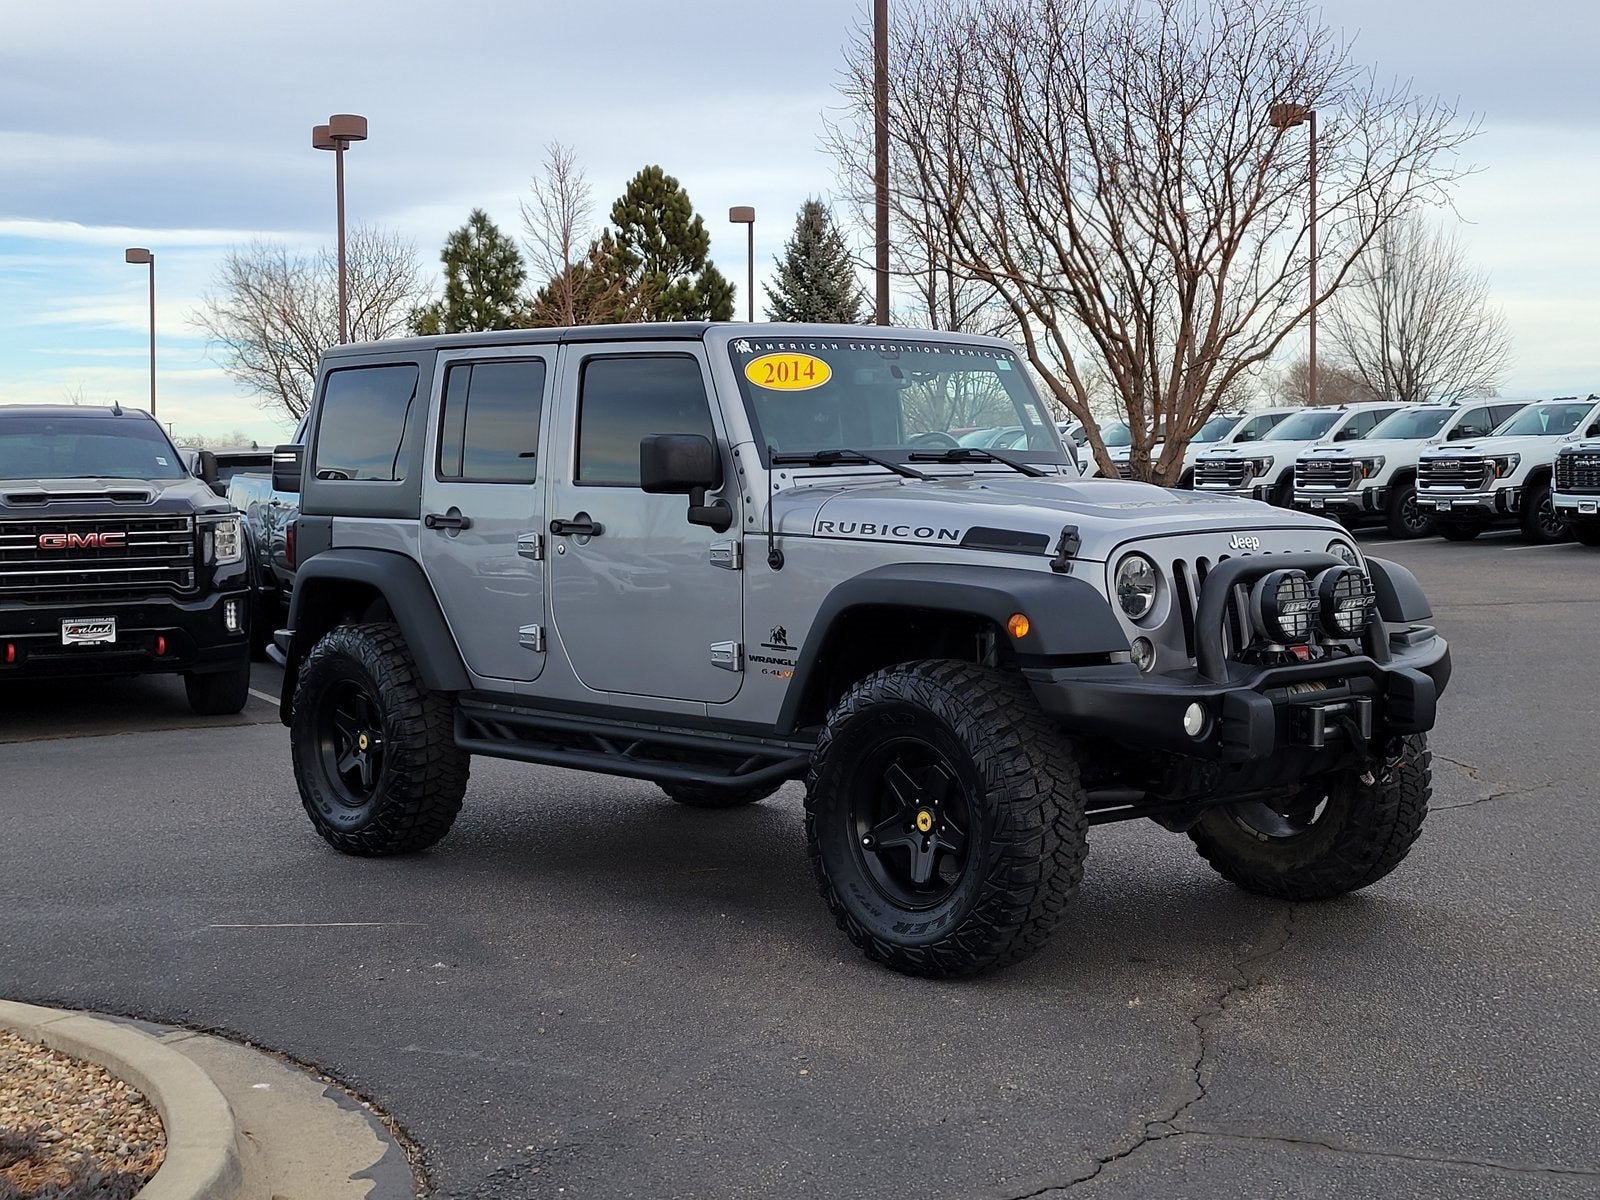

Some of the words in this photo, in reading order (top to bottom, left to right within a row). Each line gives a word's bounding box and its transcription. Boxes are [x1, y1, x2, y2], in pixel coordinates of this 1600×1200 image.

[755, 342, 839, 351] AMERICAN
[849, 343, 941, 354] EXPEDITION
[949, 348, 1016, 362] VEHICLES
[763, 359, 815, 384] 2014
[817, 520, 961, 541] RUBICON
[39, 532, 126, 549] GMC
[1229, 534, 1260, 551] Jeep
[65, 624, 112, 635] Loveland
[748, 654, 798, 667] WRANGL
